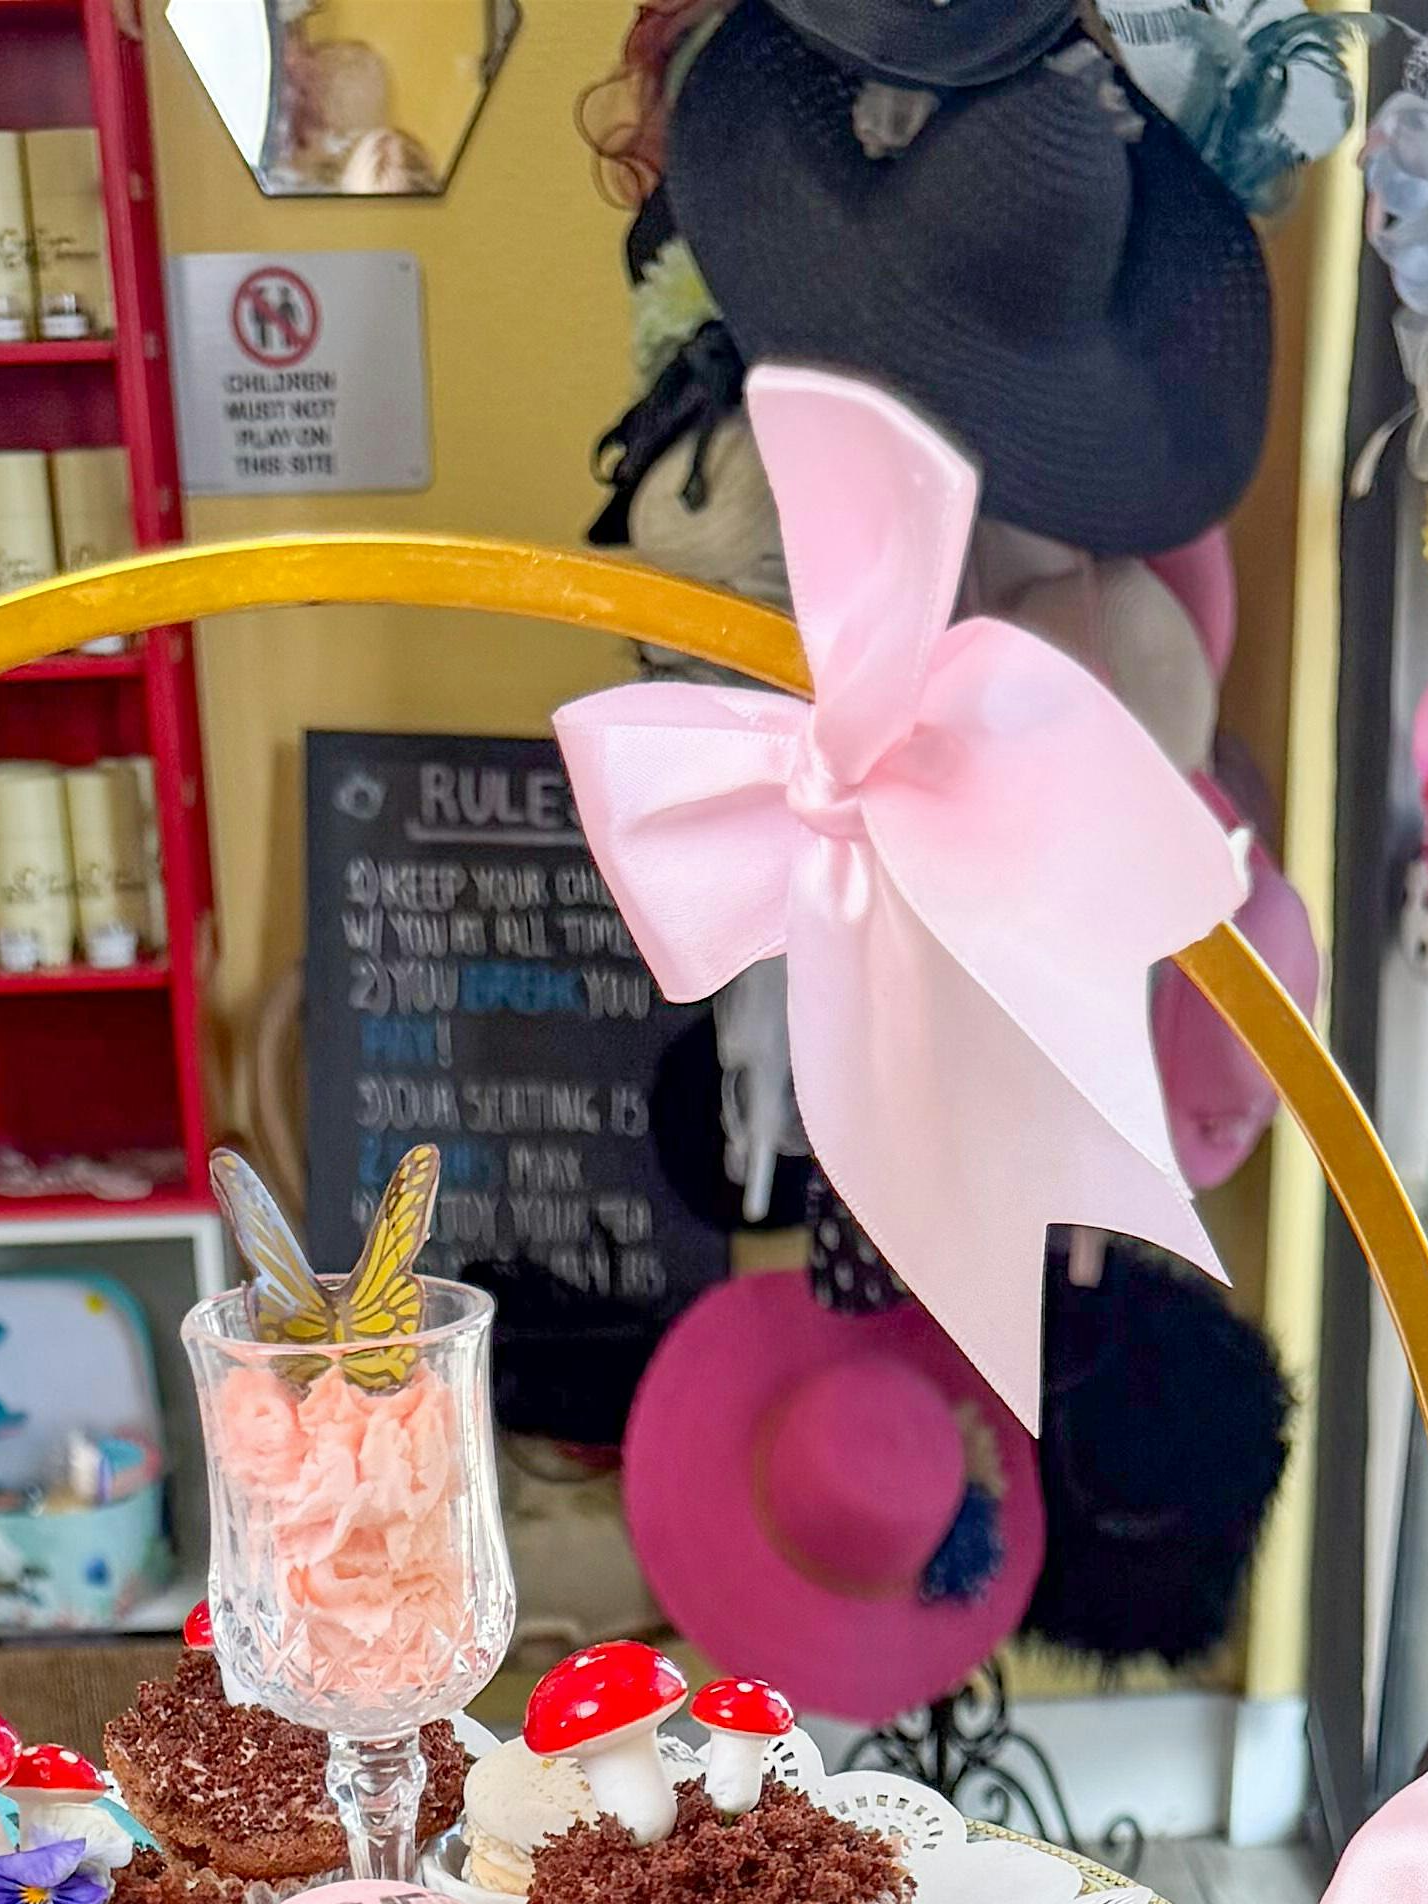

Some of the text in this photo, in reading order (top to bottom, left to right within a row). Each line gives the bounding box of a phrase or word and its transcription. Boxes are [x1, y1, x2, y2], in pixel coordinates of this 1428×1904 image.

[224, 372, 335, 393] CHILDREN
[225, 399, 335, 420] MUST NOT
[236, 426, 331, 449] PLAY ON
[235, 454, 333, 477] THIS SITE
[470, 864, 549, 912] YOUR
[494, 910, 553, 958] ALL
[581, 964, 651, 1019] YOU
